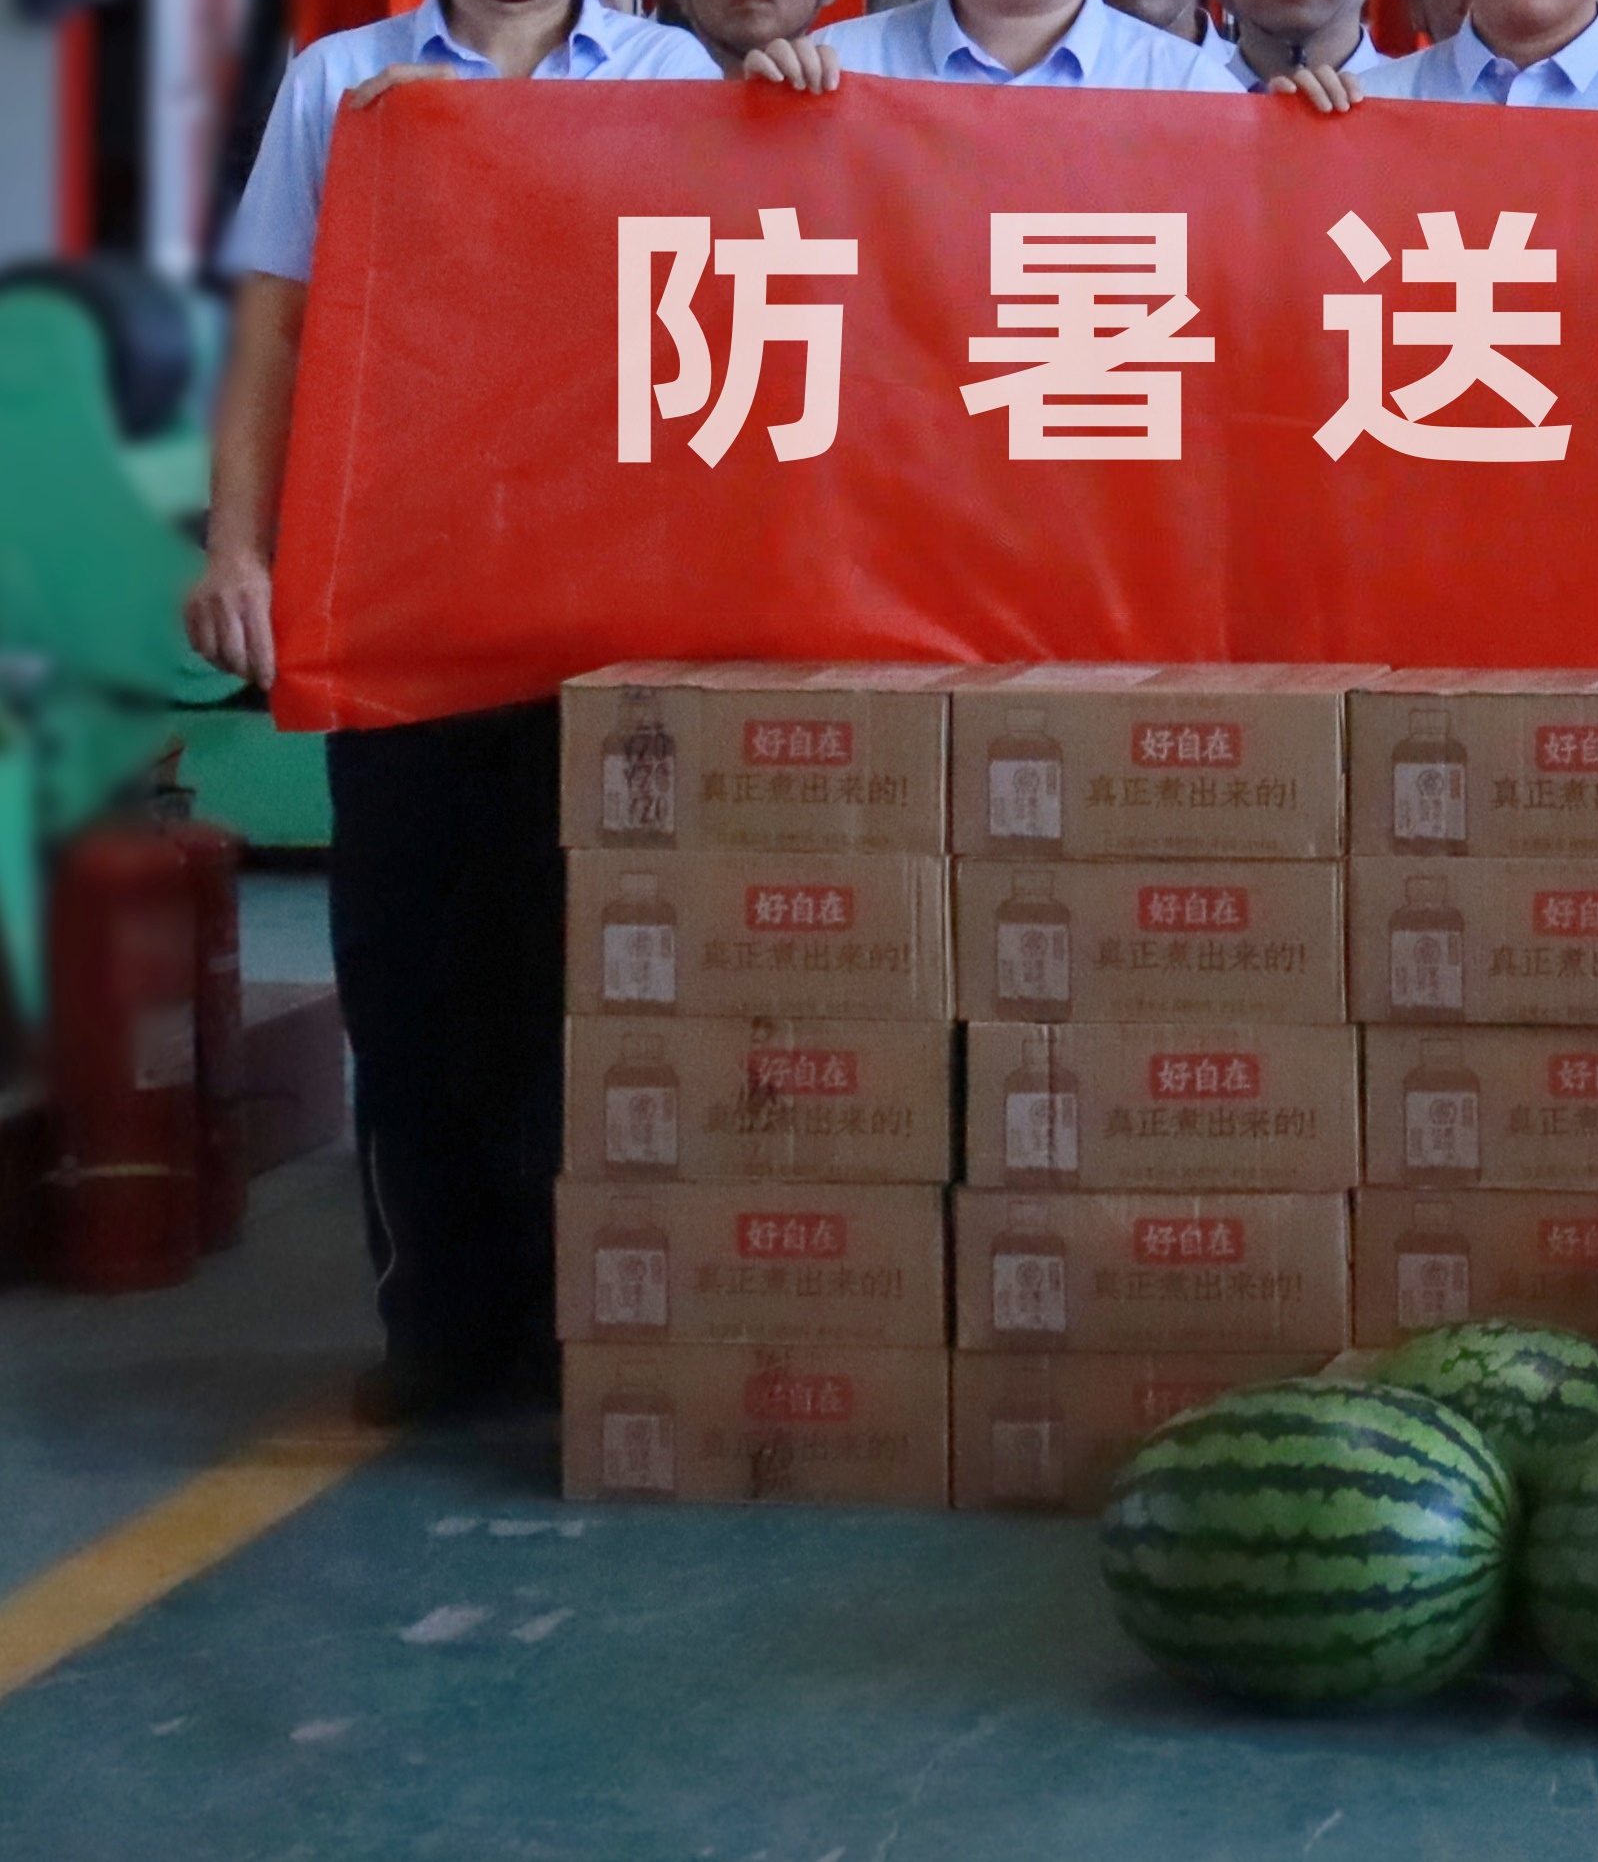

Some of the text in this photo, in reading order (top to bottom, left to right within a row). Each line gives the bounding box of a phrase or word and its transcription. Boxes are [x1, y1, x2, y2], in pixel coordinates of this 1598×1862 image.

[752, 725, 846, 760] 好自在
[1140, 728, 1234, 762] 好自在
[756, 891, 846, 926] 好自在
[1148, 891, 1240, 926] 好自在
[1158, 1058, 1252, 1093] 好自在
[745, 1219, 840, 1252] 好自在
[1141, 1223, 1235, 1257] 好自在
